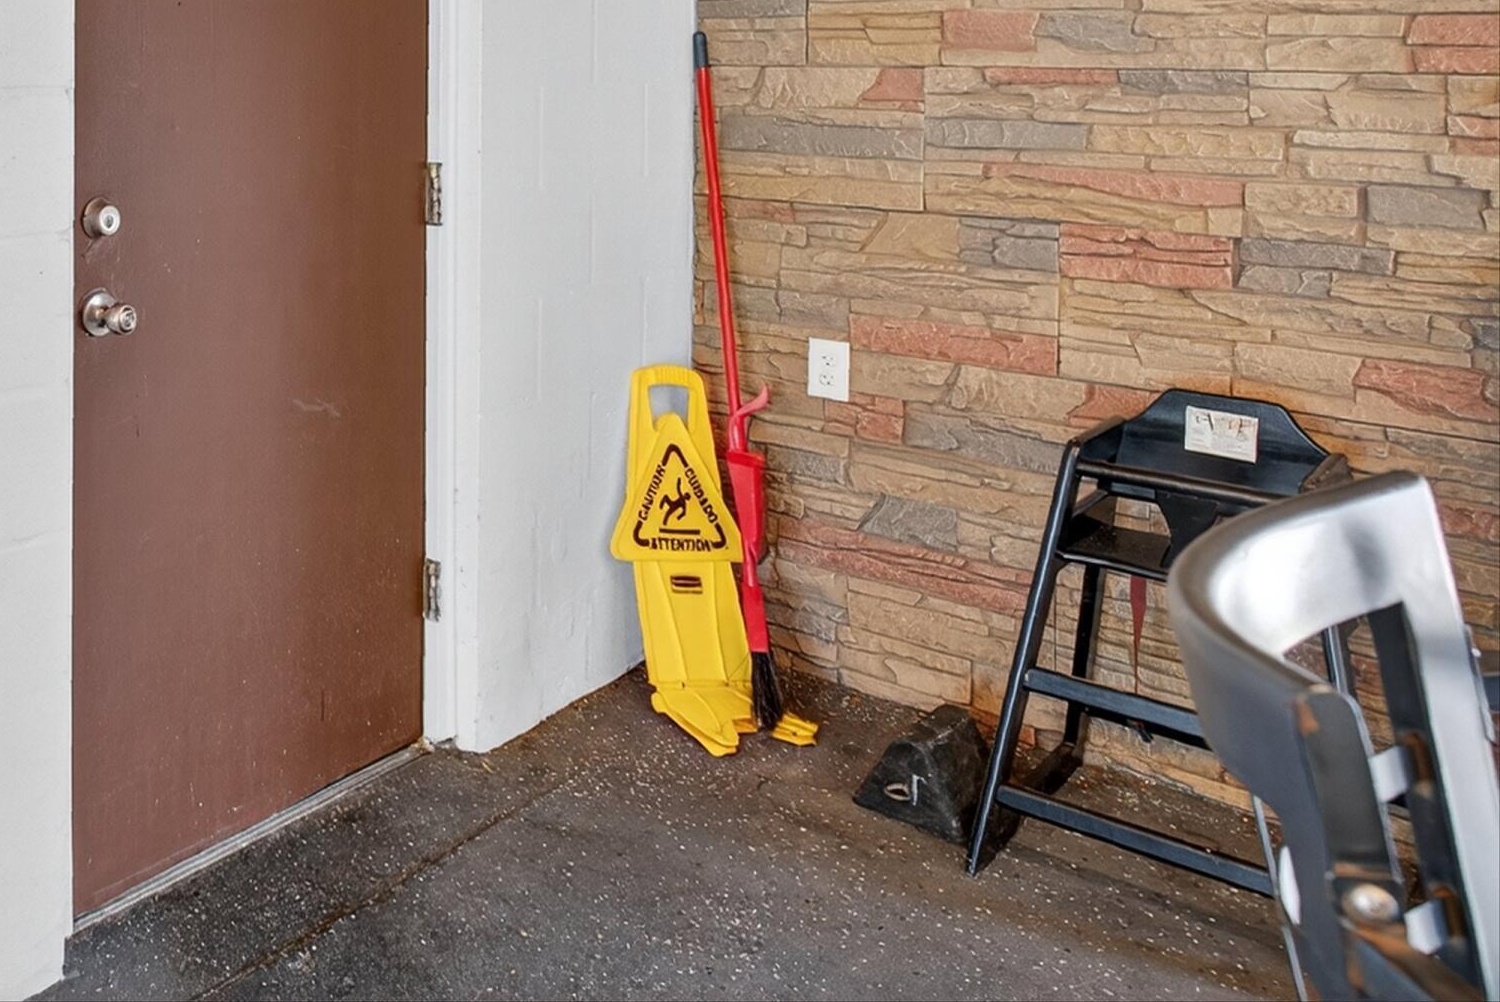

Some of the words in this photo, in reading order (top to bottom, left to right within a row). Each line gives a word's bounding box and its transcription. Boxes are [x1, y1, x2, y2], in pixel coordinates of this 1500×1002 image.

[637, 464, 666, 521] CAUTION
[685, 467, 718, 524] CUIDADO
[650, 537, 712, 552] ATTENTION
